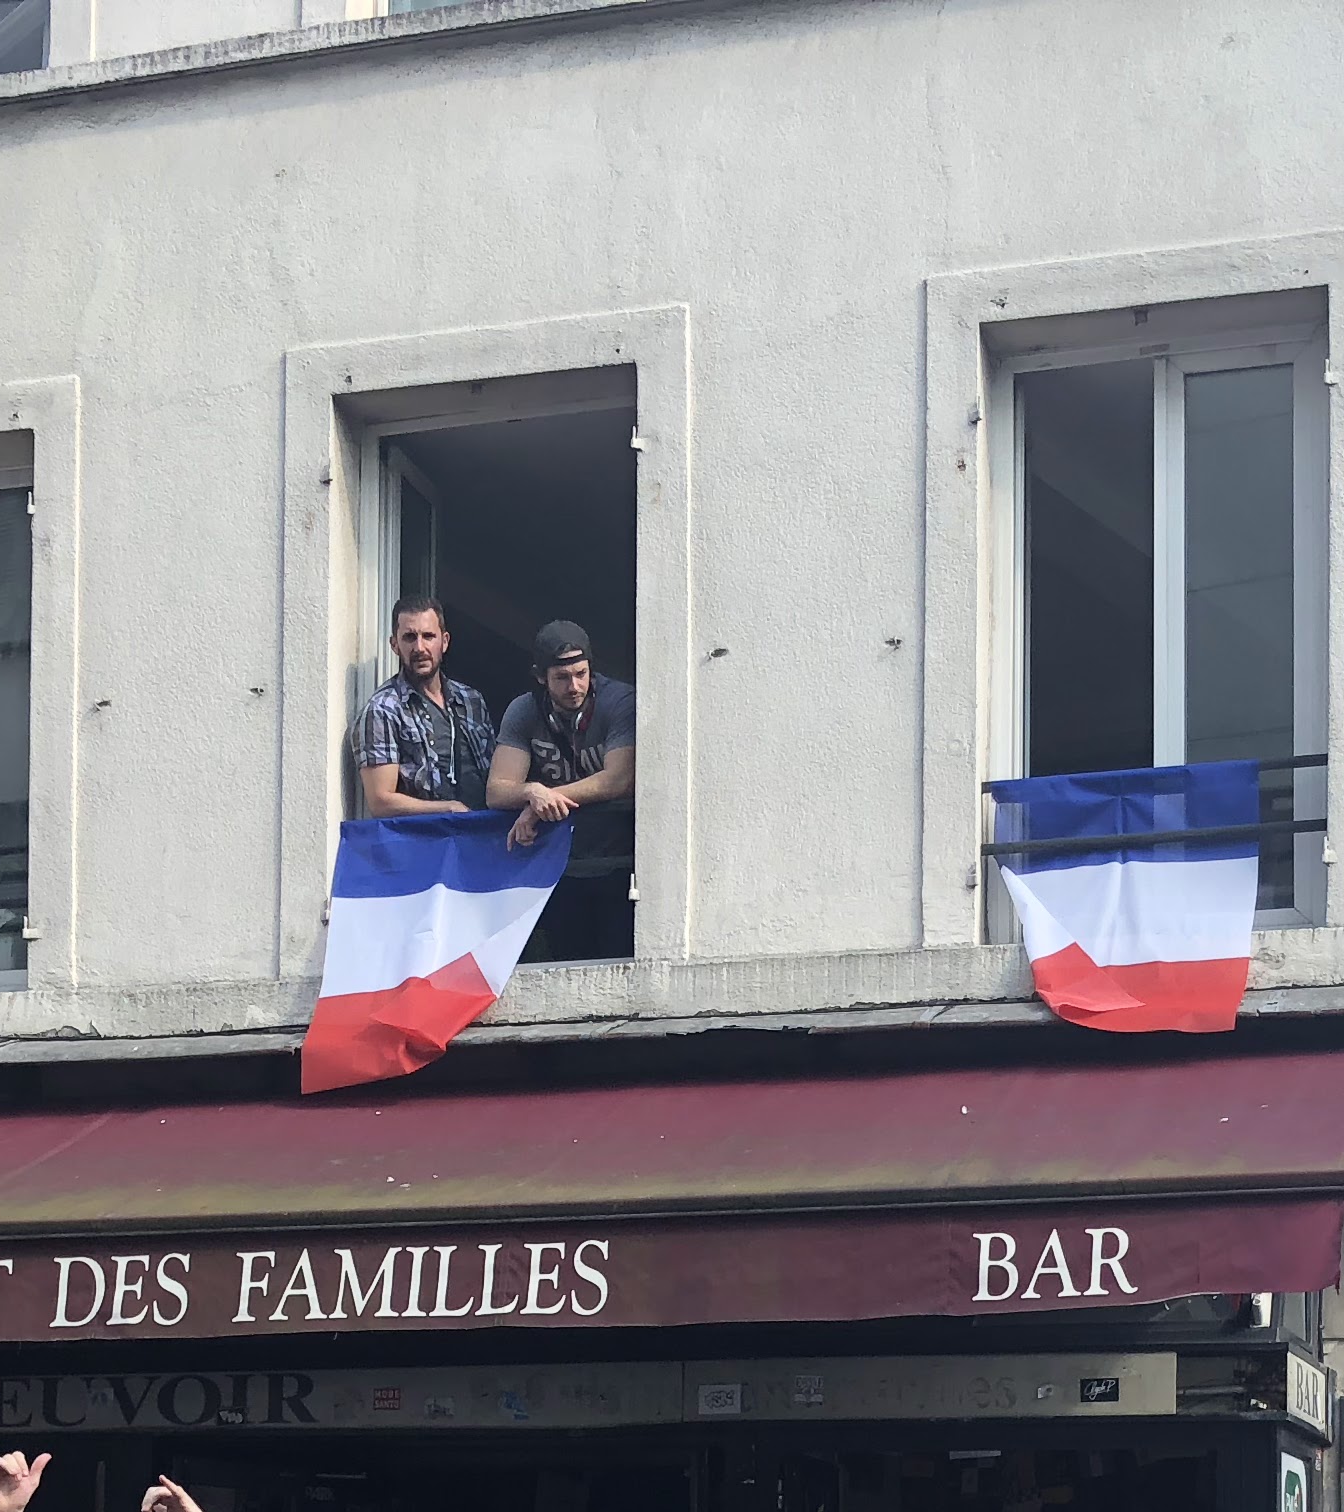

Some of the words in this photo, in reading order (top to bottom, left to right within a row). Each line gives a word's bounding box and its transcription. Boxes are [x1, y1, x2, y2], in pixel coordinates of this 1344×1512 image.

[49, 1252, 192, 1328] DES
[231, 1239, 611, 1323] FAMILLES
[971, 1227, 1139, 1302] BAR
[1296, 1361, 1320, 1422] BAR
